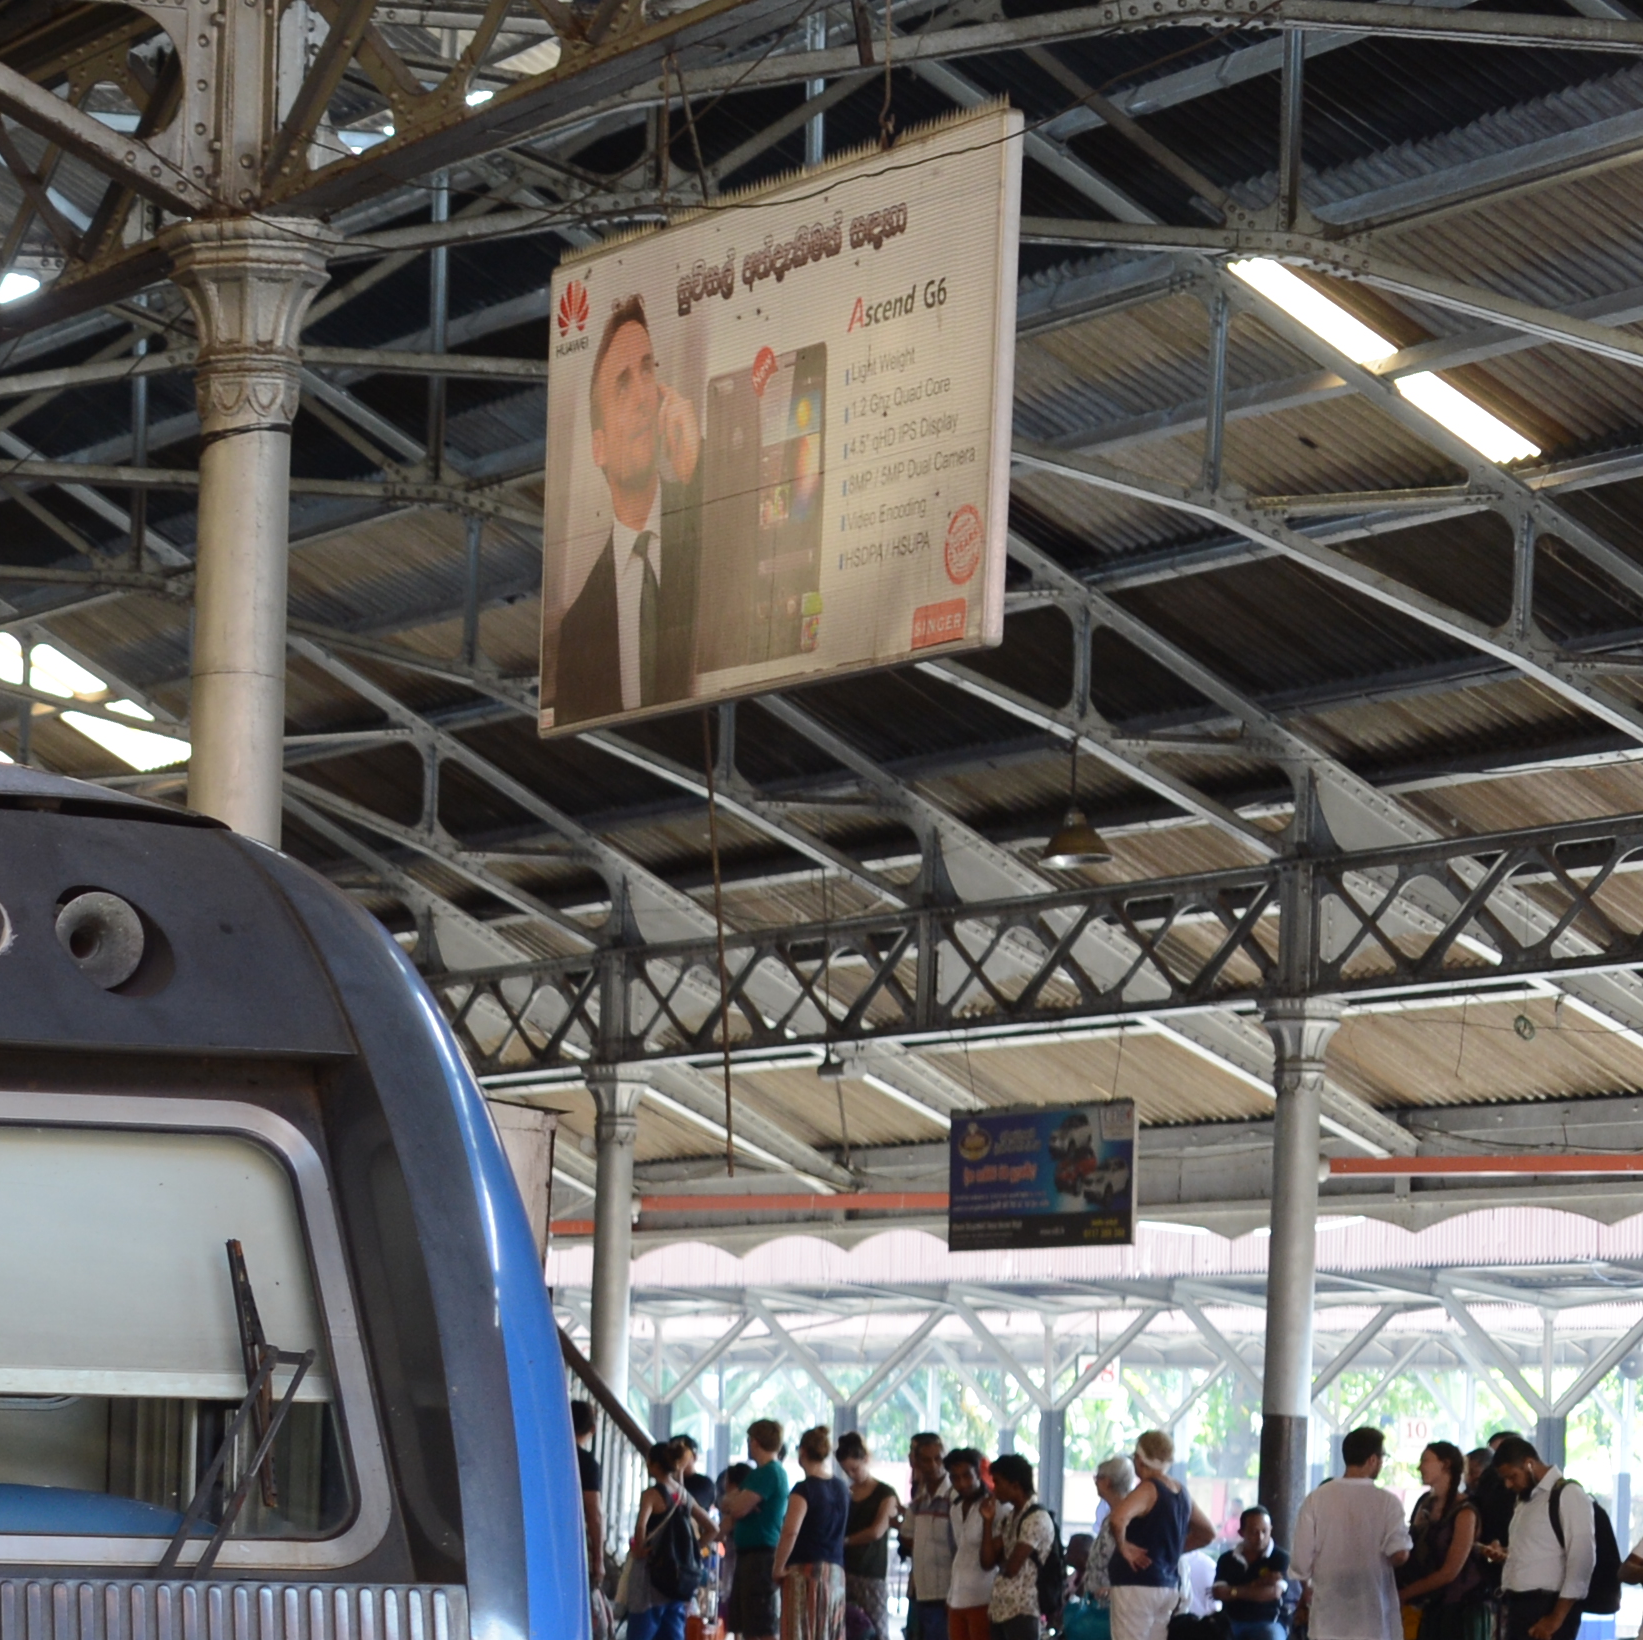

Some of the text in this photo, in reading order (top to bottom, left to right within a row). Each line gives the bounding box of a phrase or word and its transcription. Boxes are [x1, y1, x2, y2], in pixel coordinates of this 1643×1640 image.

[847, 277, 948, 333] Ascend G6
[555, 335, 590, 358] HUAWEI
[851, 347, 916, 383] Light Weight
[894, 381, 923, 407] Quad
[925, 377, 951, 398] Core
[872, 427, 896, 455] qHD
[898, 420, 916, 445] IPS
[920, 412, 959, 438] Display
[881, 461, 905, 486] 5MP
[907, 455, 933, 479] Dual
[934, 447, 976, 472] Camera
[846, 508, 876, 531] Video
[878, 499, 927, 524] Encoding
[845, 543, 883, 570] HSDPA
[892, 531, 931, 557] HSUPA
[915, 612, 963, 638] SINGER
[1407, 1421, 1428, 1439] 10
